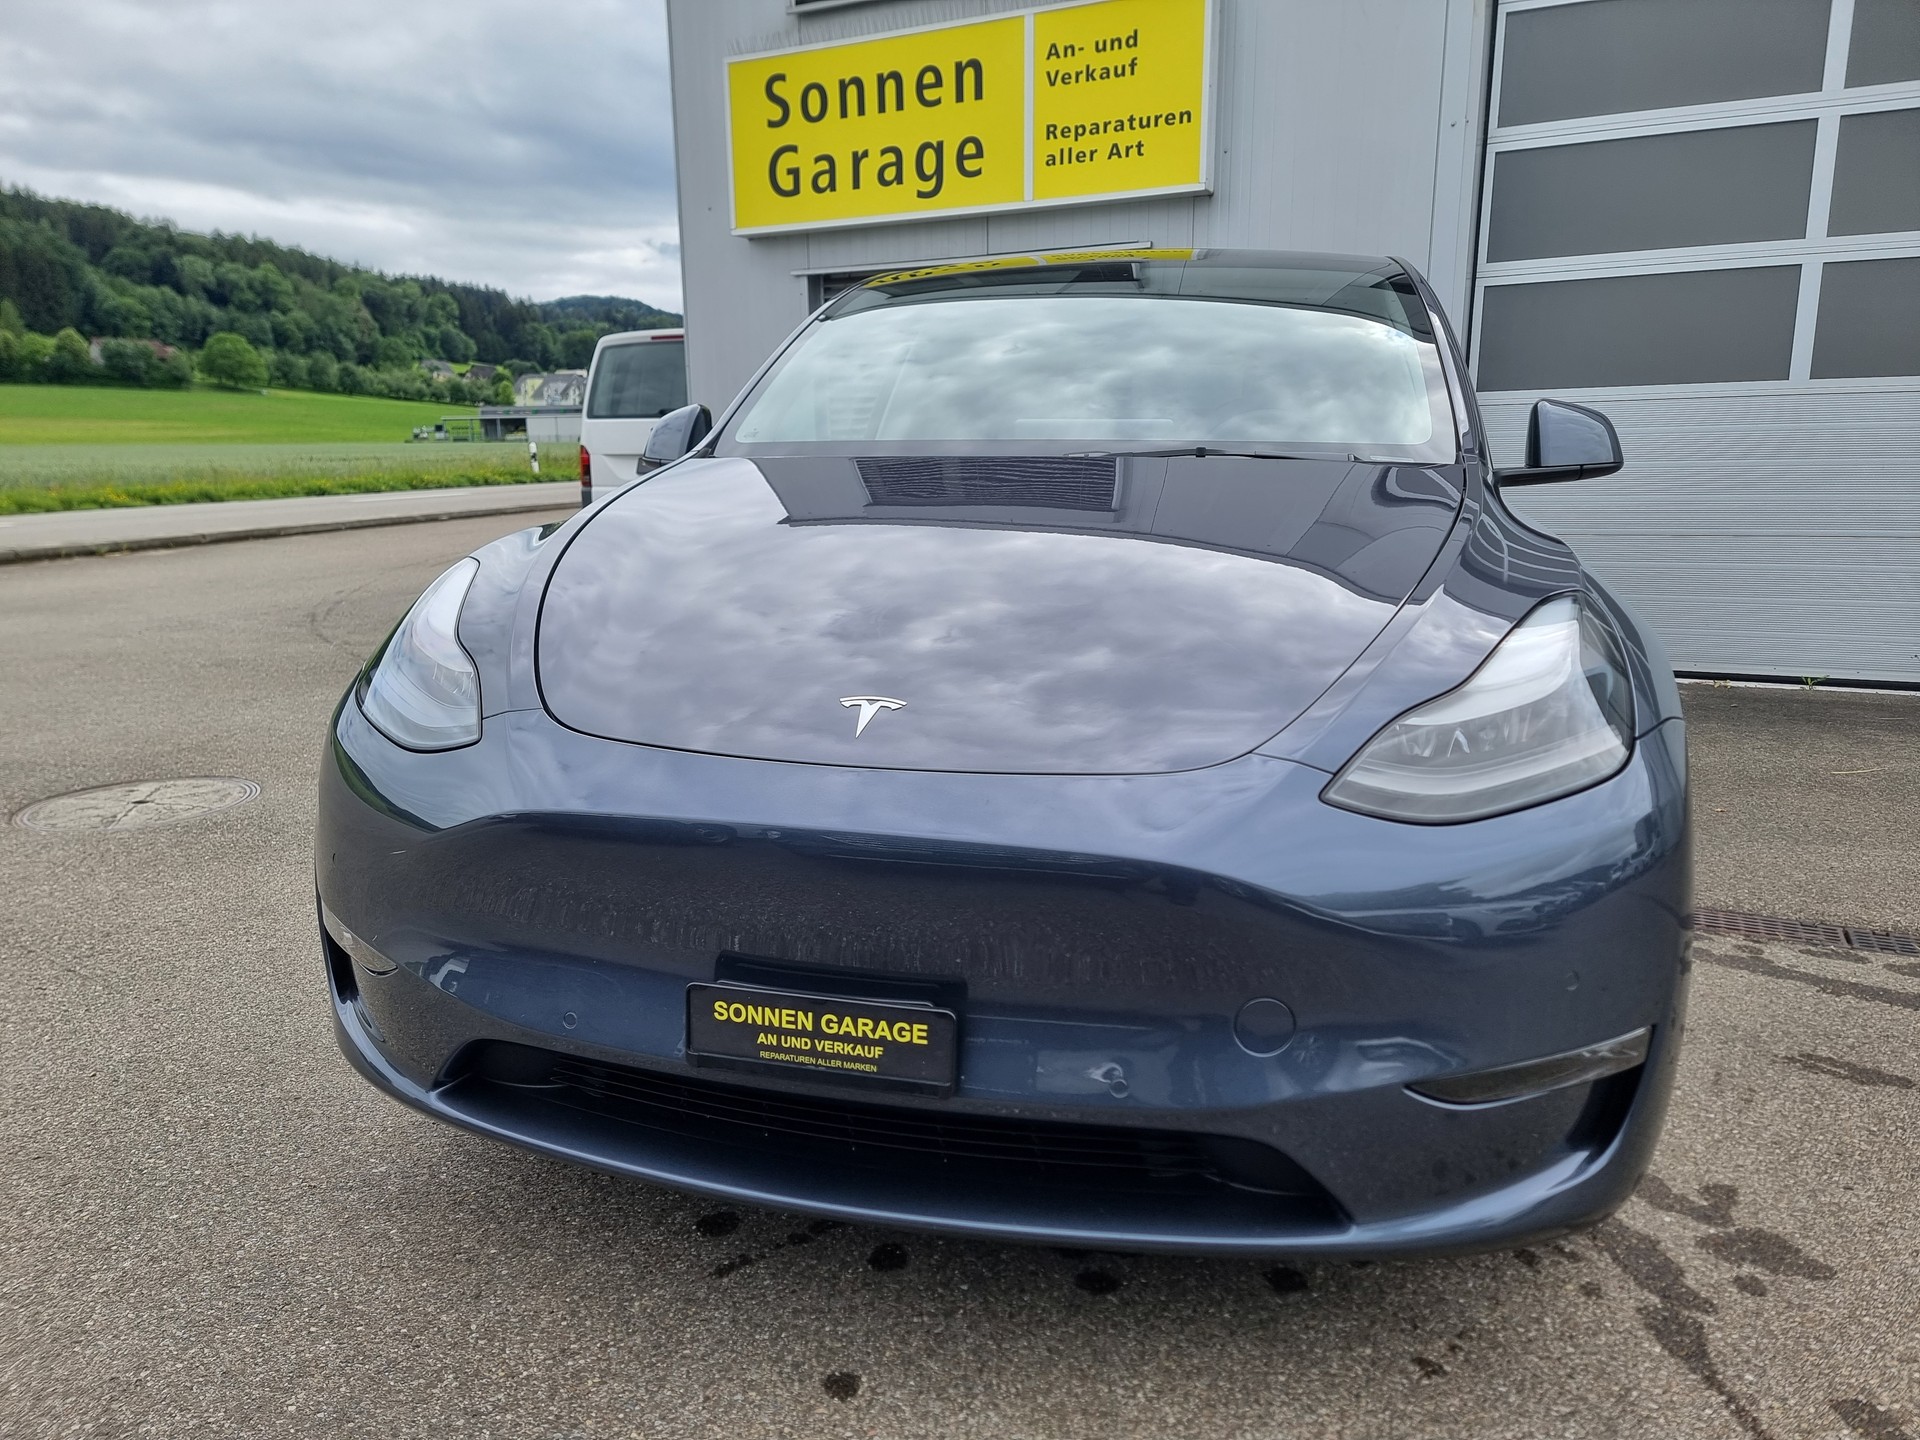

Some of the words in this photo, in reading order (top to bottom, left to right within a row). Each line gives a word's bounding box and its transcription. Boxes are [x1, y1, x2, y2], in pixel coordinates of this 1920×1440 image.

[1046, 42, 1085, 61] An-
[1094, 29, 1139, 53] und
[1046, 57, 1139, 87] Verkauf
[764, 56, 984, 129] Sonnen
[1045, 109, 1193, 141] Reparaturen
[768, 134, 984, 198] Garage
[1045, 147, 1098, 167] aller
[1107, 140, 1145, 160] Art
[713, 1000, 813, 1032] SONNEN
[820, 1013, 929, 1045] GARAGE
[756, 1032, 778, 1046] AN
[780, 1035, 812, 1051] UND
[814, 1039, 884, 1059] VERKAUF
[759, 1050, 816, 1065] REPARATUREN
[816, 1058, 843, 1069] ALLER
[843, 1061, 878, 1073] MARKEN
